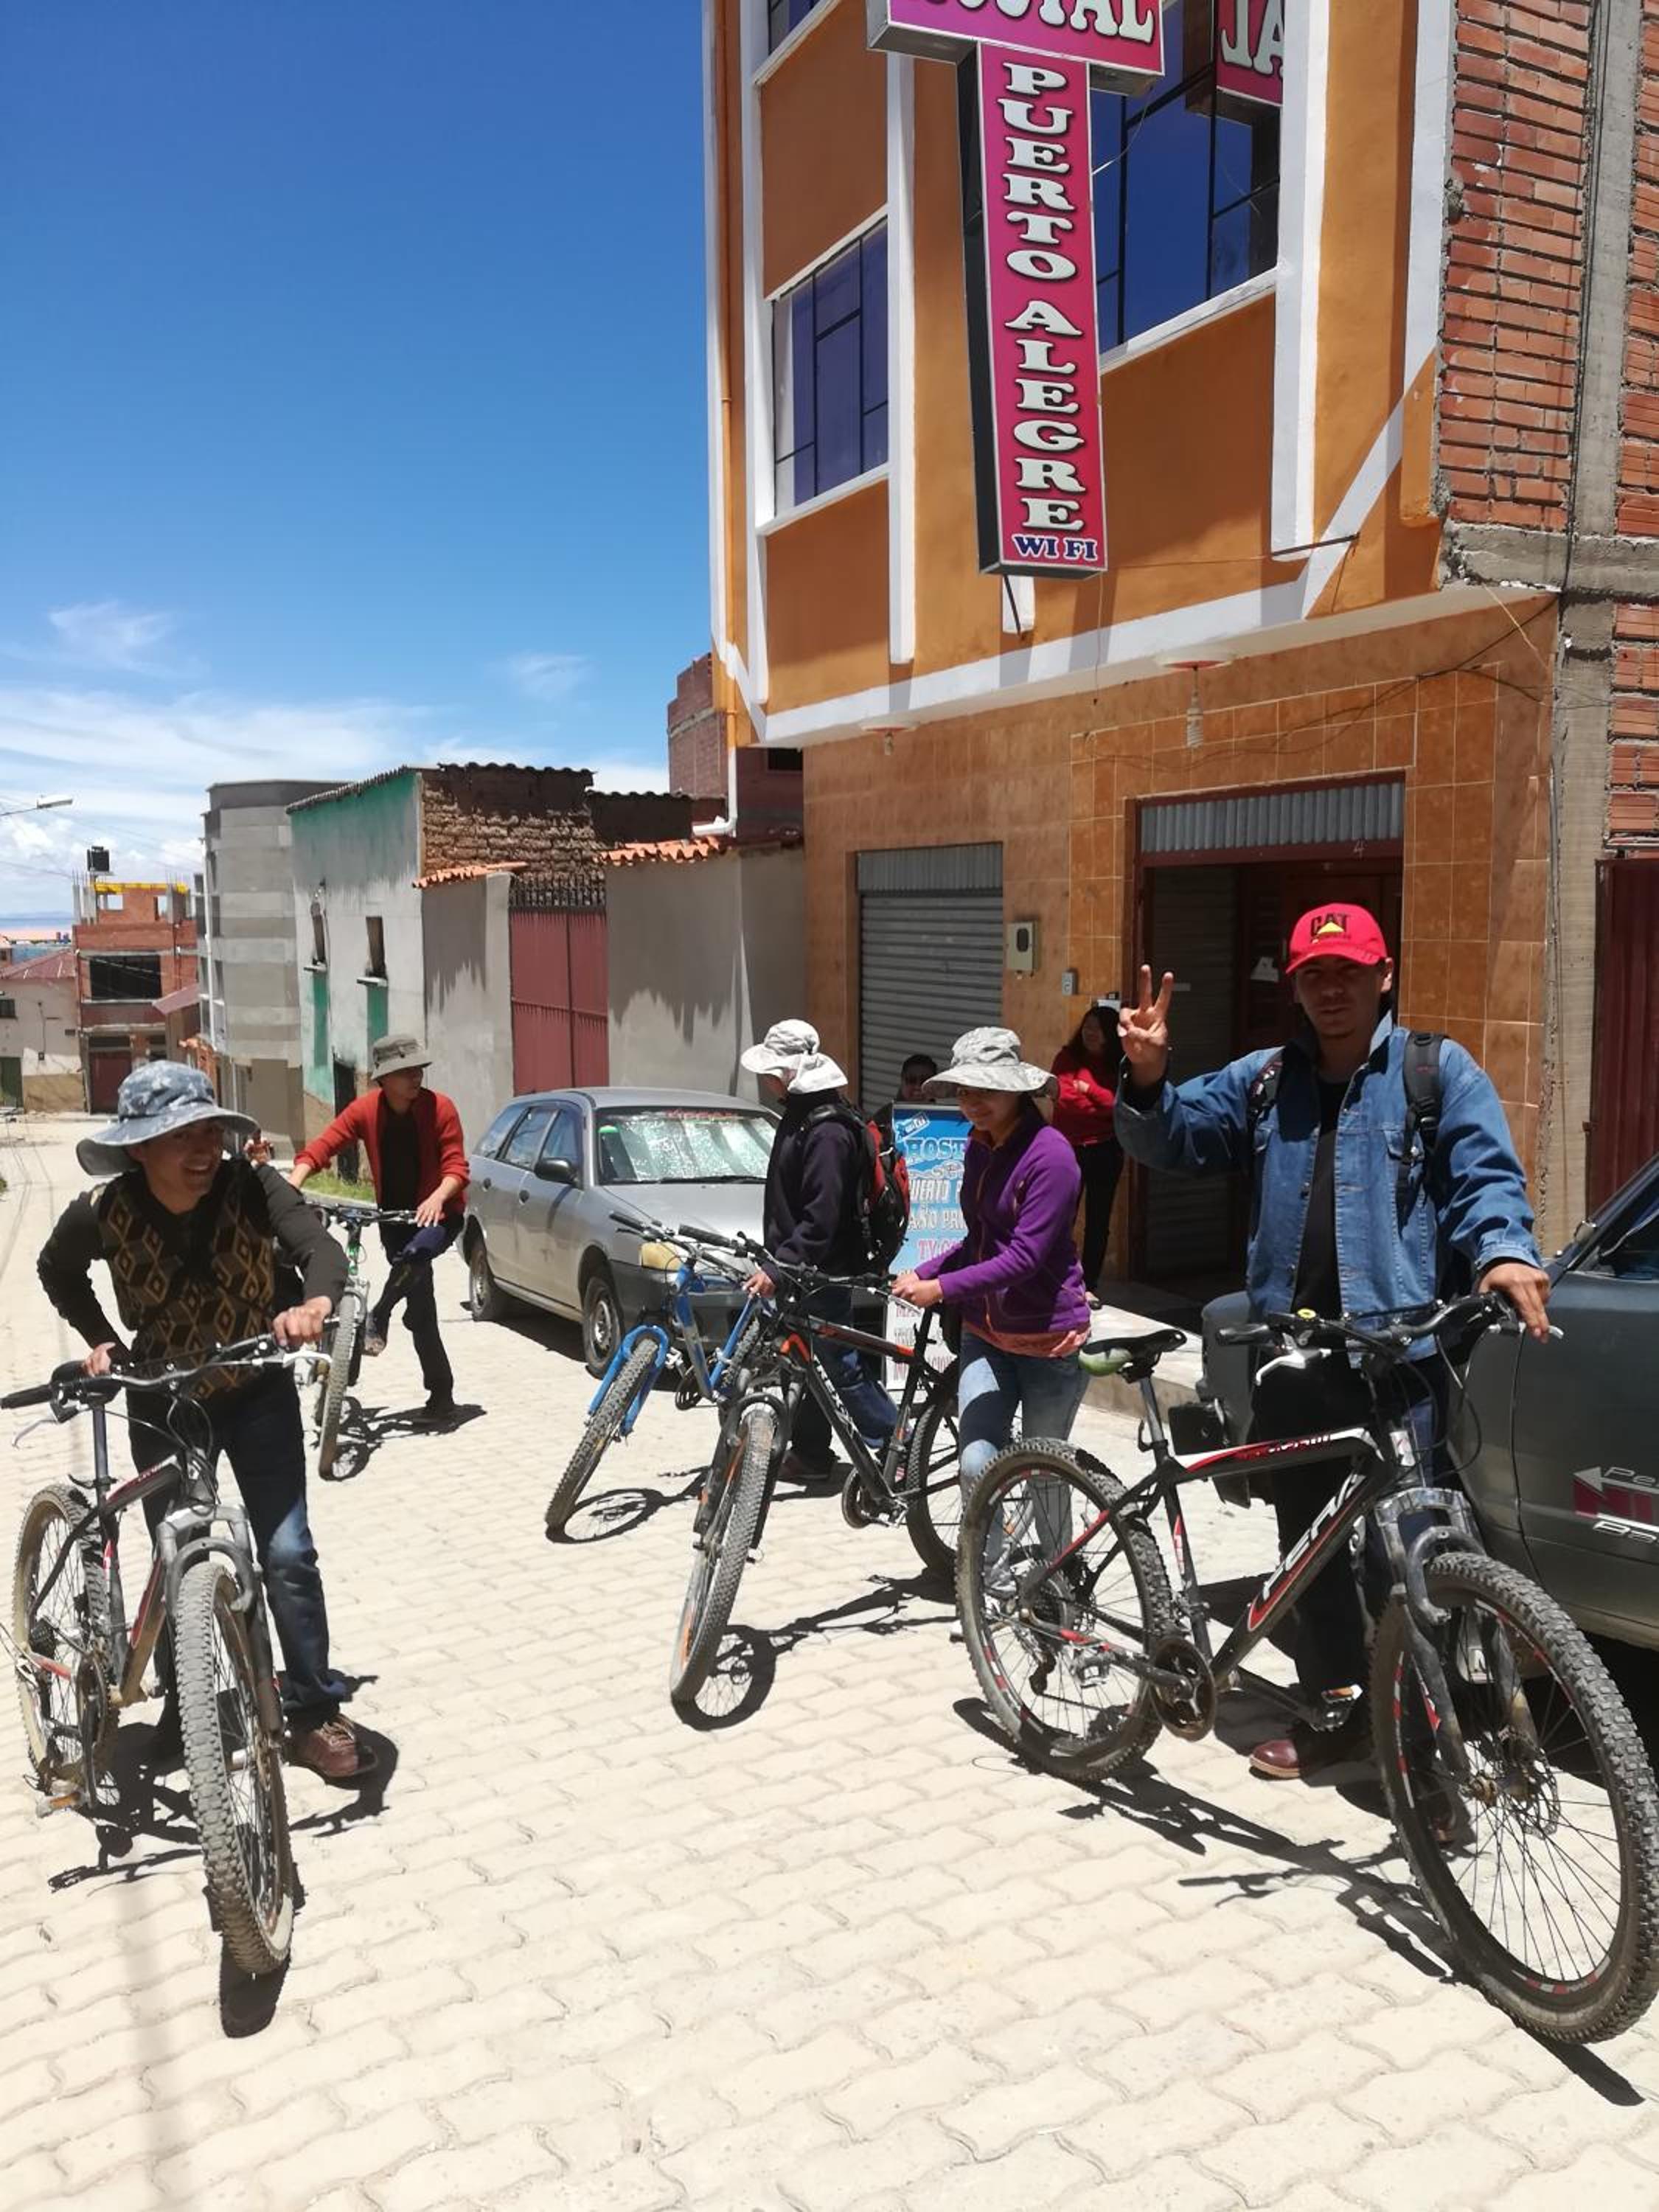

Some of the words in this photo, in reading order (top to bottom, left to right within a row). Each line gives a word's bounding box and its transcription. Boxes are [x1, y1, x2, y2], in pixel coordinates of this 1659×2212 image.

[998, 62, 1077, 281] PUERTO
[1005, 300, 1085, 531] ALEGRE
[1012, 535, 1057, 558] WI
[1064, 538, 1097, 560] FI
[1310, 913, 1350, 937] CAT
[903, 1136, 969, 1161] HOST
